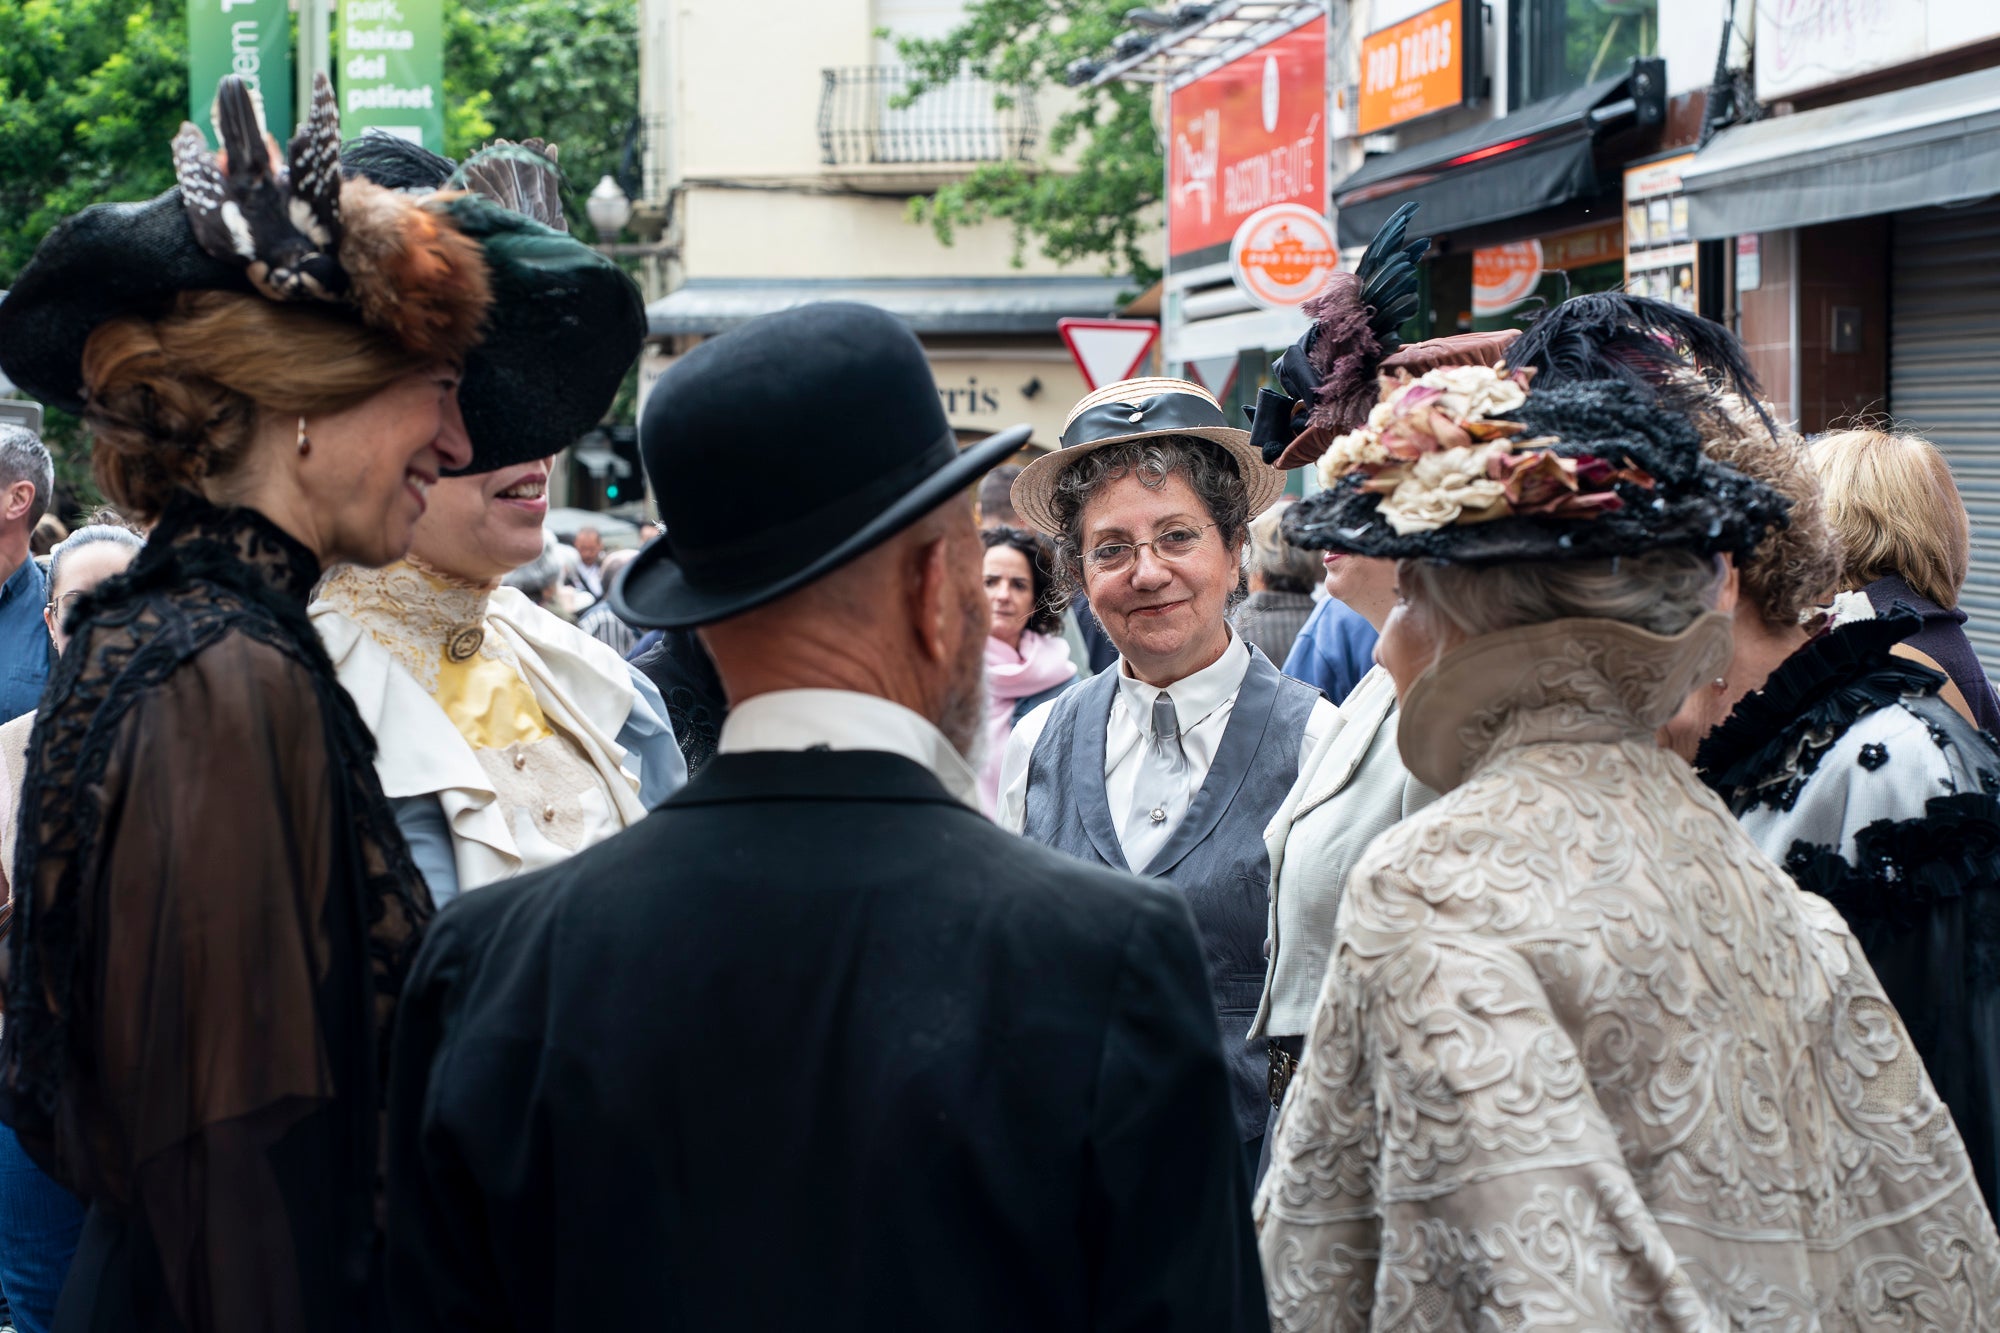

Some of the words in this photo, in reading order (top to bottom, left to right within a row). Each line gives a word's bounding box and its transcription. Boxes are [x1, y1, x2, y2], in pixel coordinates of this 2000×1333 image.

[346, 26, 414, 50] baixa
[346, 54, 386, 79] del
[1366, 42, 1398, 96] PRO
[1401, 18, 1452, 83] TACOS
[347, 84, 434, 113] patinet
[938, 378, 999, 415] ris
